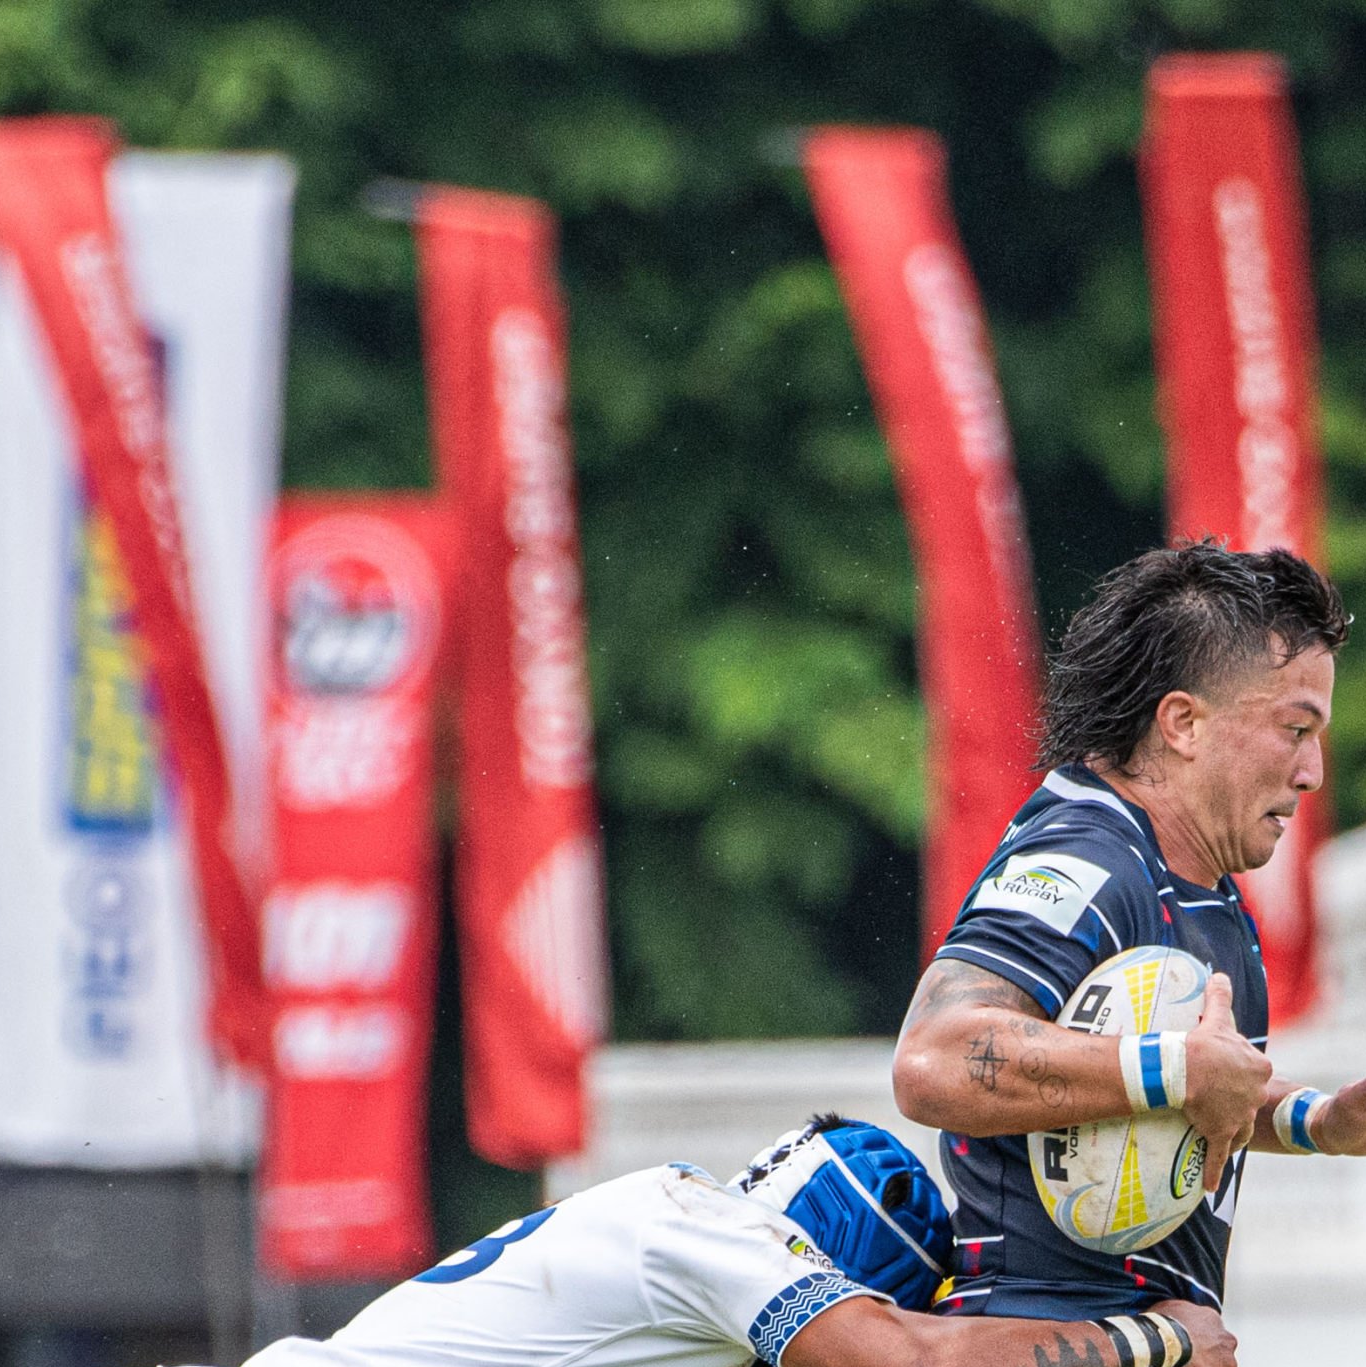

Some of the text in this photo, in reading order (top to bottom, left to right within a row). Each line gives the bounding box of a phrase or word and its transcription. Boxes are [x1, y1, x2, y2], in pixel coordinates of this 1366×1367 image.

[1003, 882, 1065, 905] RUGBY
[1015, 874, 1059, 894] ASIA
[1182, 1135, 1205, 1181] ASIA
